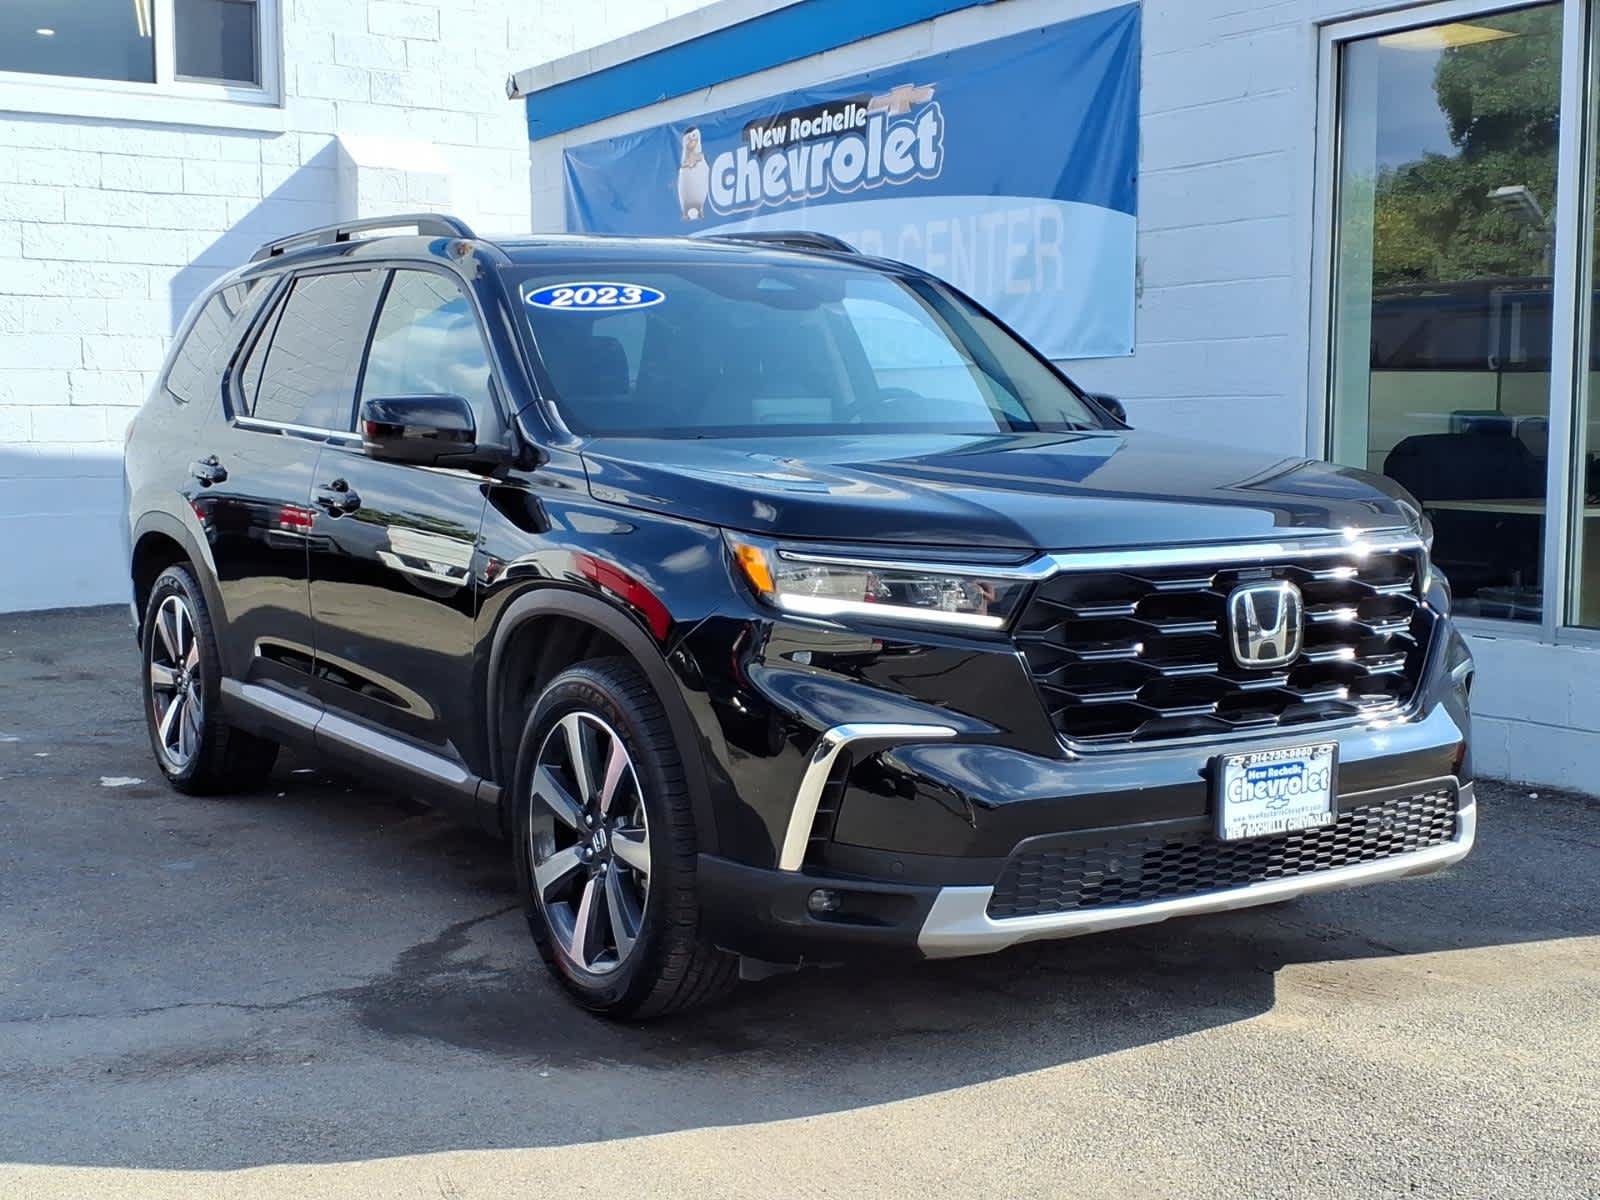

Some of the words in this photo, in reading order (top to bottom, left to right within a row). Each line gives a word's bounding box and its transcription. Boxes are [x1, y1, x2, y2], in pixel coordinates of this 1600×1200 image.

[750, 126, 786, 151] New
[790, 104, 866, 141] Rochelle
[710, 109, 939, 207] Chevrolet
[900, 204, 1064, 298] CENTER
[550, 287, 643, 306] 2023
[1228, 767, 1330, 803] Chevrolet
[1248, 770, 1267, 780] New
